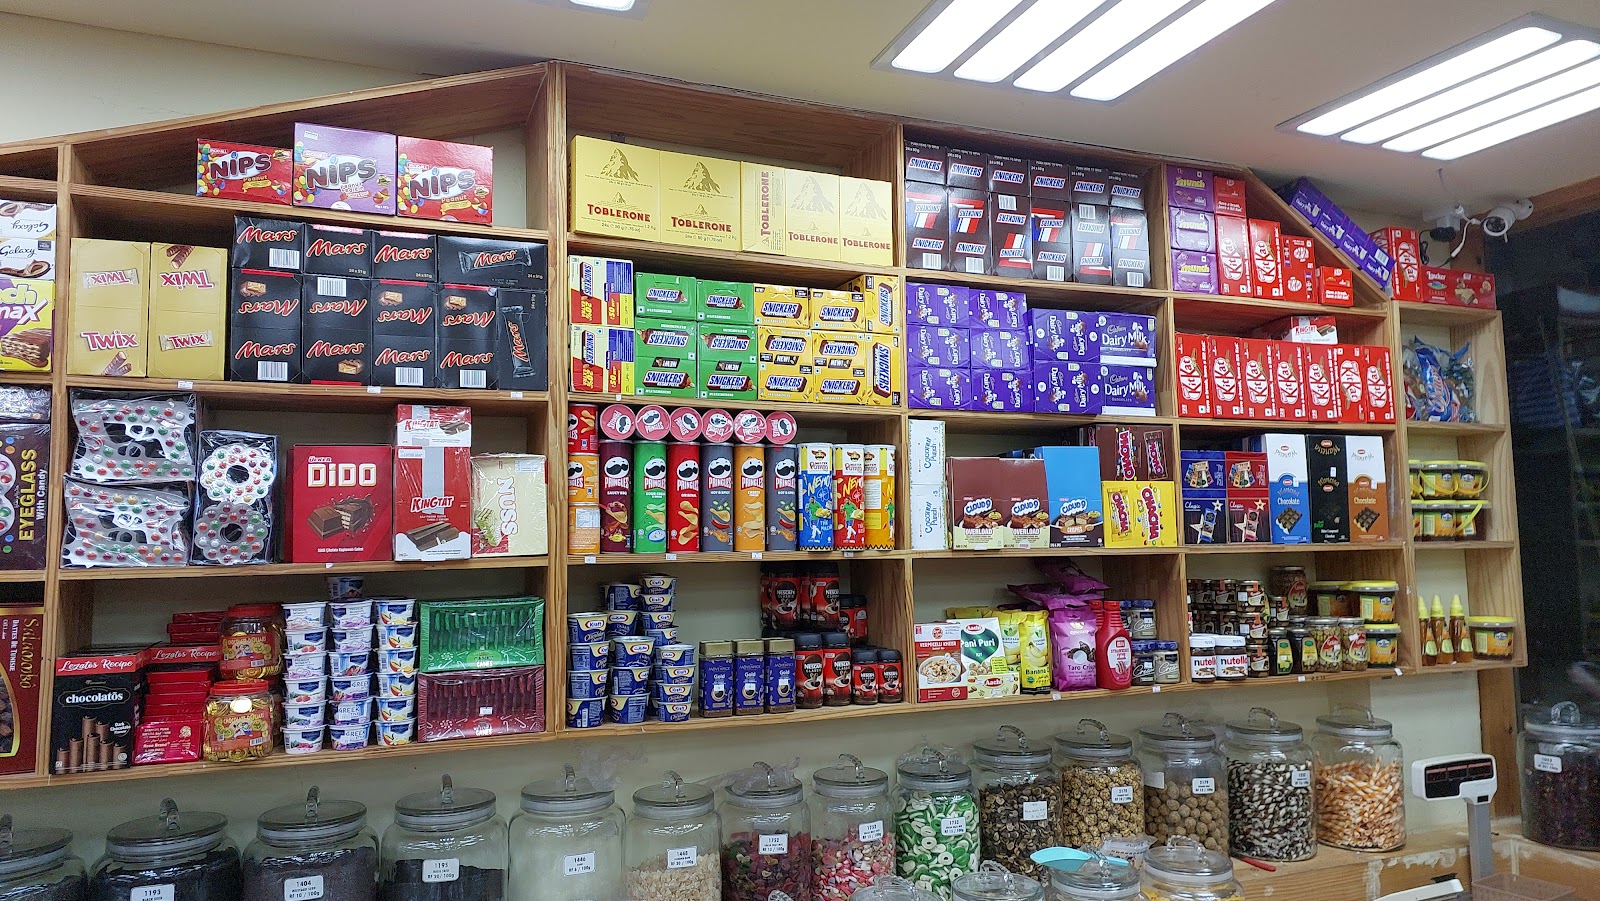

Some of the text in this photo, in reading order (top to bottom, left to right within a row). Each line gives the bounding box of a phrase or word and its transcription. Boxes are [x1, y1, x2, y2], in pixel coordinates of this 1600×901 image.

[210, 151, 272, 180] NIPS
[306, 155, 377, 188] NIPS
[909, 158, 943, 171] SNICKERS
[951, 164, 983, 177] SNICKERS
[408, 166, 476, 199] NIPS
[993, 171, 1024, 182] SNICKERS
[1034, 176, 1066, 188] SNICKERS
[1074, 182, 1104, 193] SNICKERS
[1111, 186, 1141, 197] SNICKERS
[761, 171, 771, 236] TOBLERONE
[587, 204, 651, 222] TOBLERONE
[12, 219, 49, 233] Galaxy
[671, 216, 732, 233] TOBLERONE
[236, 226, 298, 244] Mars
[788, 231, 838, 245] TOBLERONE
[842, 237, 891, 250] TOBLERONE
[0, 245, 37, 258] Galaxy
[306, 239, 368, 257] Mars
[374, 244, 434, 264] Mars
[474, 250, 517, 269] Mars
[1257, 243, 1276, 280] KitKat
[237, 298, 299, 315] Mars
[310, 299, 367, 316] Mars
[377, 306, 433, 324] Mars
[763, 302, 797, 314] SNICKERS
[821, 307, 855, 317] SNICKERS
[443, 310, 496, 327] Mars
[509, 321, 529, 361] Mars
[770, 340, 806, 352] SNICKERS
[1102, 331, 1148, 347] Dairy Milk
[235, 341, 298, 360] Mars
[306, 340, 367, 358] Mars
[375, 348, 432, 367] Mars
[824, 344, 859, 356] SNICKERS
[440, 350, 495, 369] Mars
[645, 371, 684, 384] SNICKERS
[709, 375, 746, 387] SNICKERS
[767, 376, 803, 389] SNICKERS
[822, 379, 856, 390] SNICKERS
[1180, 359, 1202, 394] KitKat
[1214, 360, 1235, 396] KitKat
[1246, 363, 1267, 398] KitKat
[1278, 364, 1298, 400] KitKat
[1310, 366, 1329, 401] KitKat
[1341, 361, 1361, 399] KitKat
[1105, 381, 1149, 397] Dairy Milk
[1367, 369, 1386, 404] KitKat
[645, 421, 664, 434] PRINGLES
[923, 437, 932, 469] Coconut
[1119, 431, 1136, 479] CHACHA
[604, 477, 630, 489] PRINGLES
[708, 478, 732, 489] PRINGLES
[19, 449, 38, 541] EYEGLASS
[36, 468, 48, 520] With Candy
[1277, 497, 1300, 505] Chocolate
[497, 477, 518, 536] NUSS
[965, 499, 986, 513] CLOUD
[1013, 500, 1034, 513] CLOUD
[1062, 502, 1081, 513] CLOUD
[1111, 492, 1129, 533] CHACHA
[1140, 487, 1160, 541] CHACHA
[924, 501, 933, 534] Coconut
[589, 620, 602, 628] Kraft
[961, 639, 977, 647] Pani
[979, 638, 995, 647] Puri
[101, 659, 133, 670] Recipe
[1194, 656, 1216, 666] nutell
[1025, 667, 1046, 675] Banana
